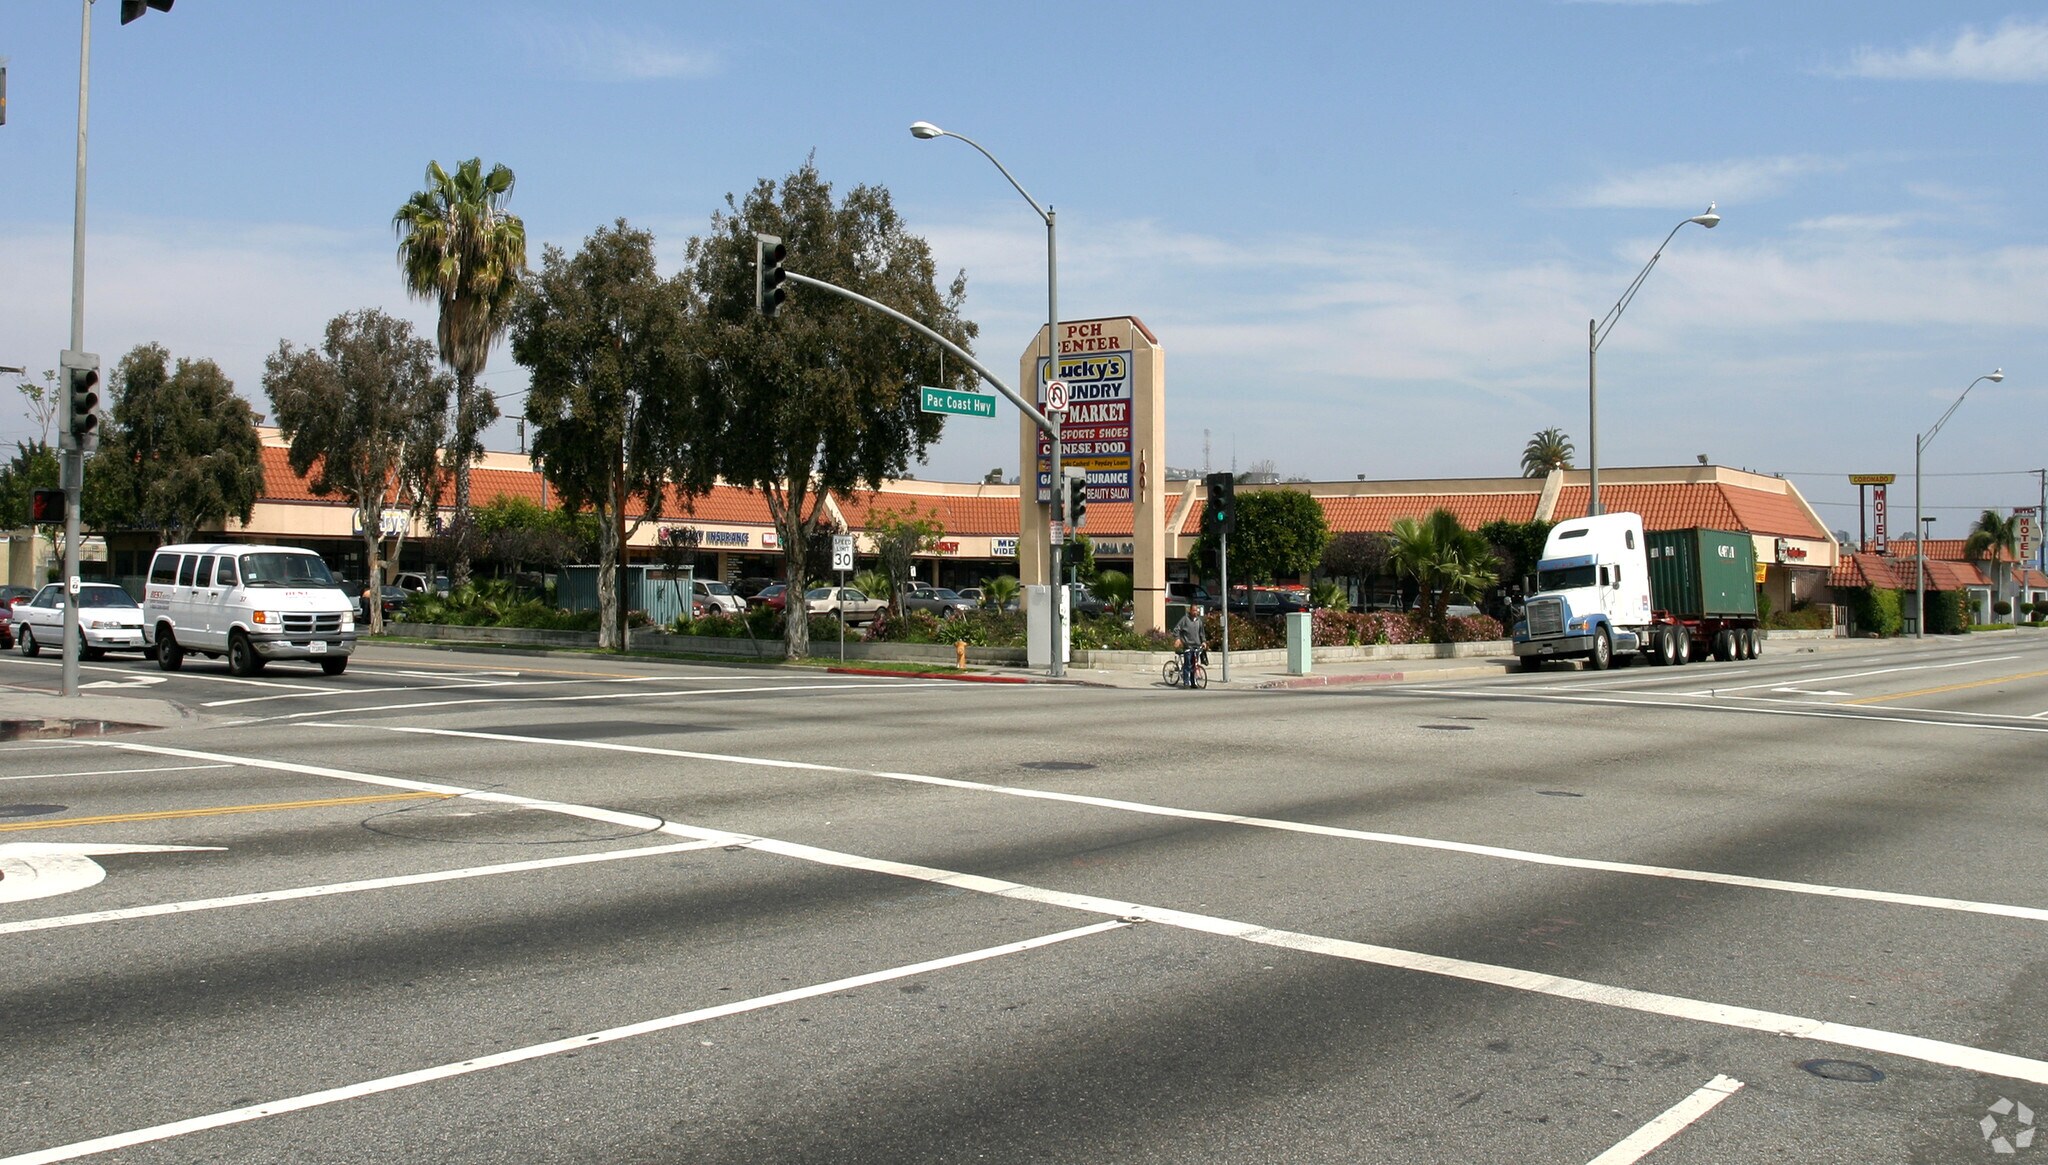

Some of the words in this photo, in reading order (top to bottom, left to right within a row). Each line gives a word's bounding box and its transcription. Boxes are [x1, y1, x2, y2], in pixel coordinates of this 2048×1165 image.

[1067, 324, 1102, 338] PCH
[1059, 359, 1119, 381] ucky's
[927, 394, 943, 407] Pac
[947, 396, 971, 411] Coast
[974, 399, 991, 415] Hwy
[1069, 403, 1126, 423] MARKET
[1061, 429, 1095, 439] SPORTS
[1099, 427, 1129, 438] SHOES
[1043, 443, 1092, 454] CNESE
[1095, 441, 1126, 453] FOOD
[1086, 473, 1128, 484] SURANCE
[1087, 488, 1109, 499] BEAUTY
[1110, 487, 1130, 499] SALON
[1875, 490, 1884, 546] MOTEL
[705, 531, 749, 545] INSURANCE
[2020, 518, 2029, 558] MOTEL
[834, 553, 851, 566] 30
